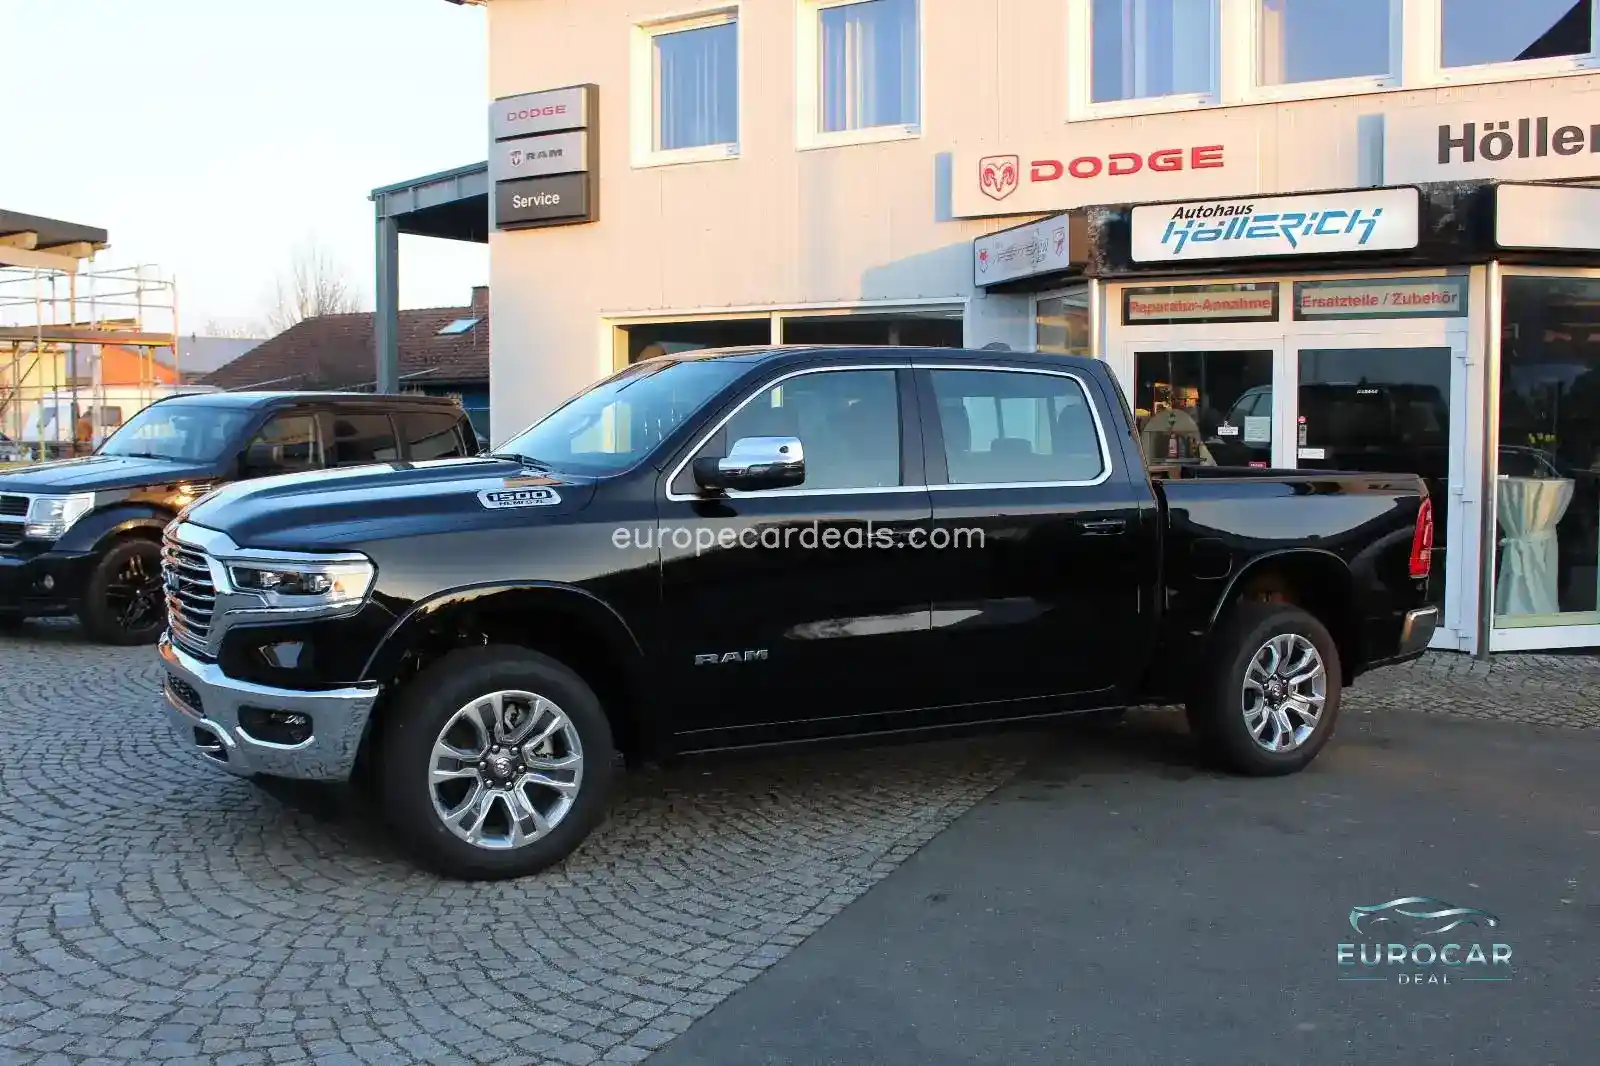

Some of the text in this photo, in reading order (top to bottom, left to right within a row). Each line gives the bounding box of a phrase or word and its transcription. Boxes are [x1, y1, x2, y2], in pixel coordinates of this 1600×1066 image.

[507, 104, 567, 121] DODGE
[526, 148, 563, 160] RAM
[1030, 145, 1225, 182] DODGE
[512, 192, 561, 209] Service
[1172, 202, 1254, 220] Autohaus
[1130, 297, 1272, 316] Reparatur-Annahme
[1302, 293, 1379, 308] Ersatzteile
[1392, 288, 1458, 306] Zubehör
[487, 490, 547, 502] 1500
[694, 649, 769, 666] RAM
